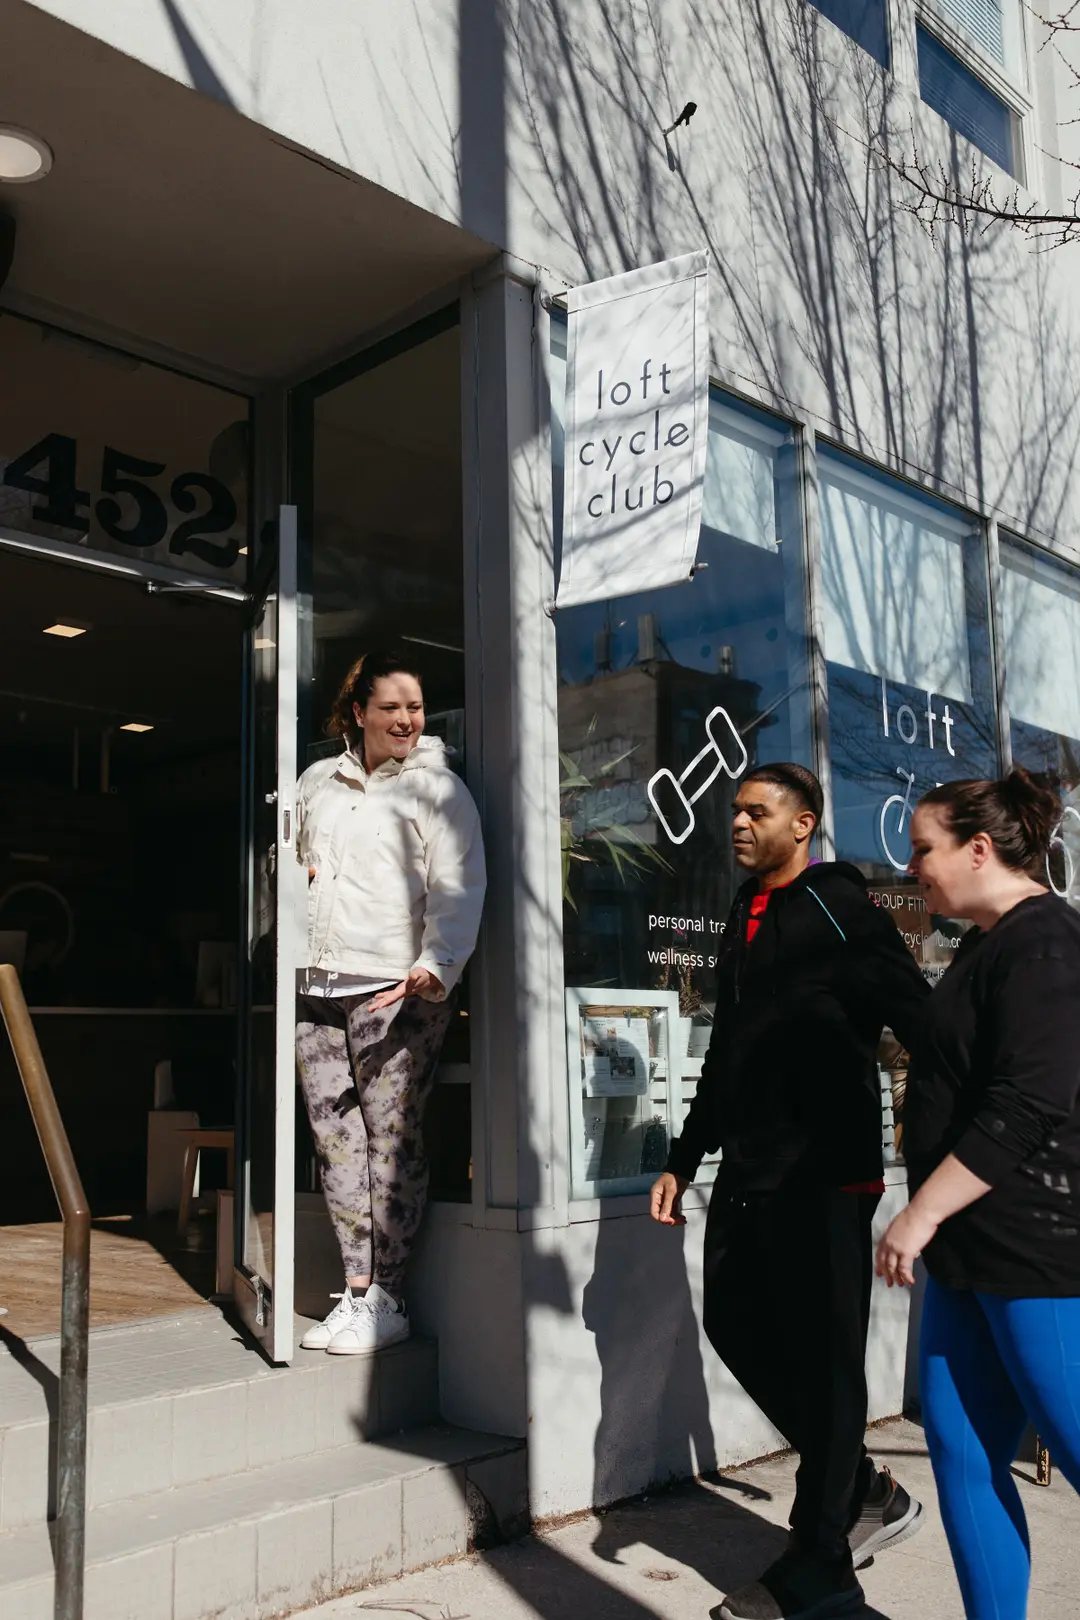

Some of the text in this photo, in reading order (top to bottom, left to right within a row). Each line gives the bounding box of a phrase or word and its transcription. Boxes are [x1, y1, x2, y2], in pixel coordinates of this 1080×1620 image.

[597, 358, 671, 410] loft
[579, 409, 690, 471] cycle
[3, 432, 240, 568] 452
[587, 464, 675, 518] club
[881, 675, 956, 757] loft
[648, 914, 705, 931] personal
[647, 948, 704, 967] wellness
